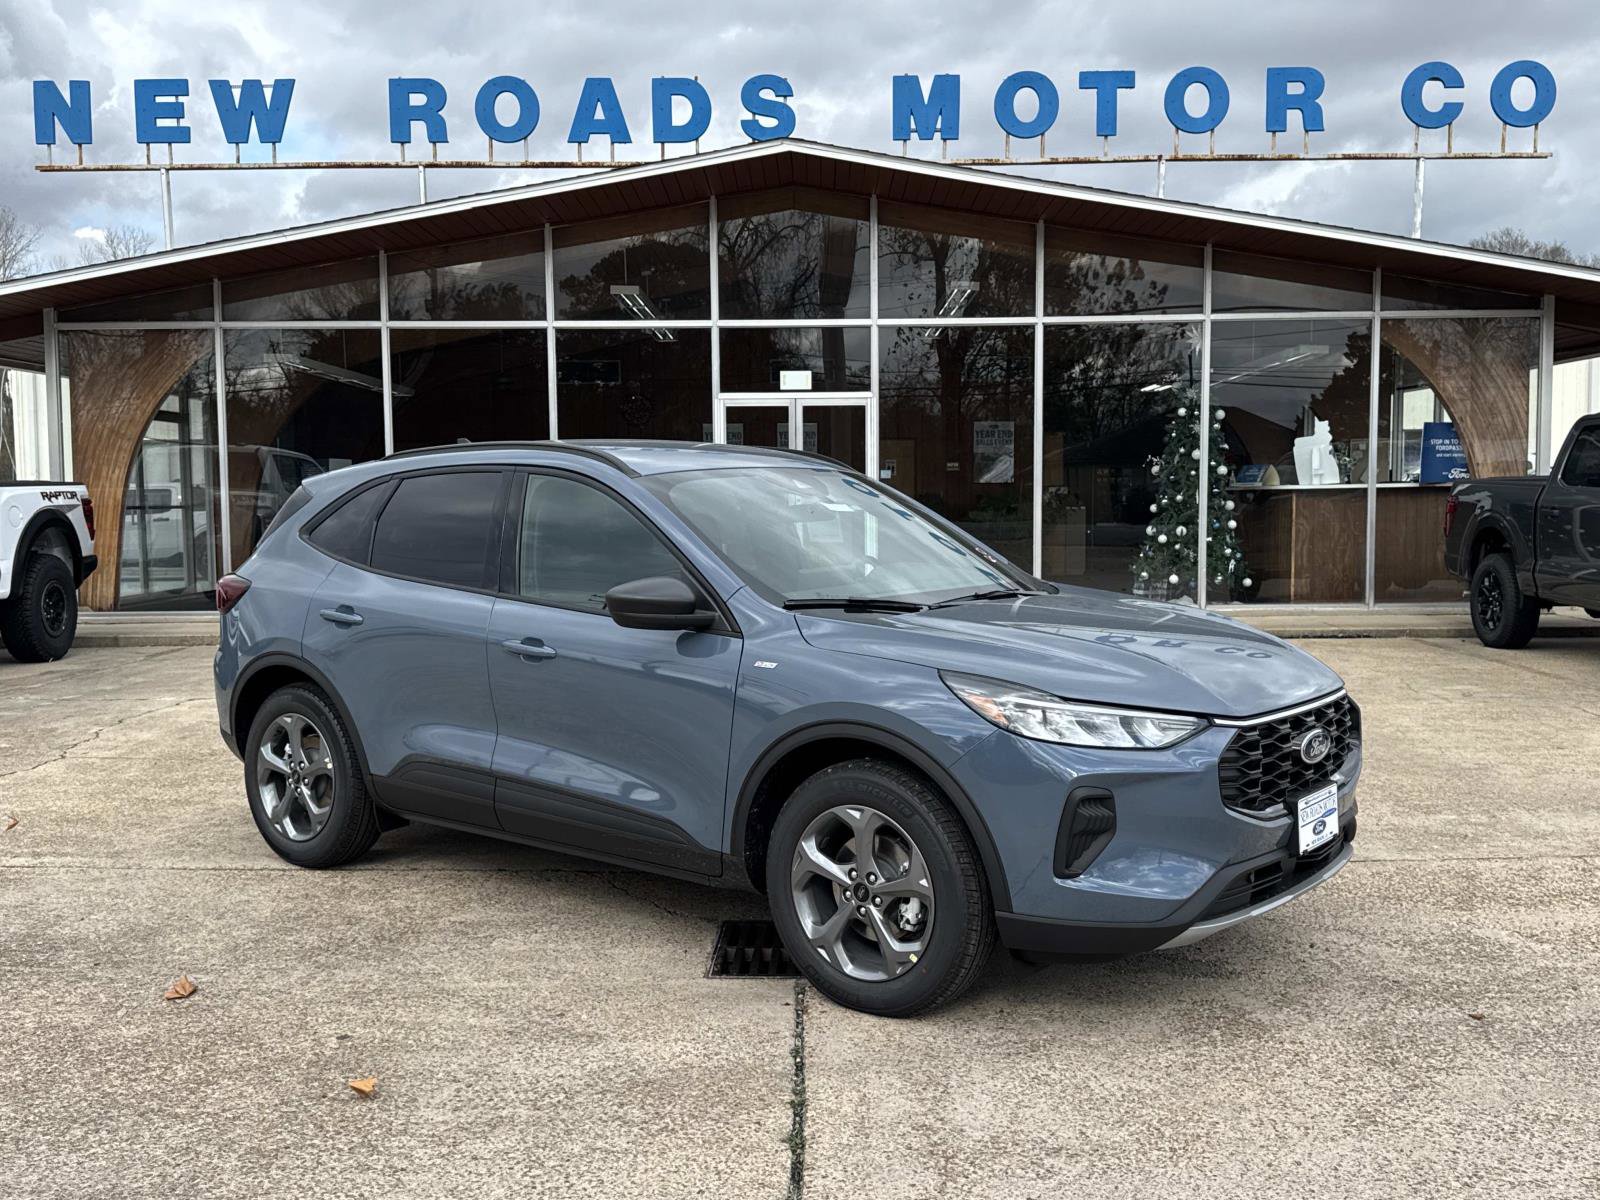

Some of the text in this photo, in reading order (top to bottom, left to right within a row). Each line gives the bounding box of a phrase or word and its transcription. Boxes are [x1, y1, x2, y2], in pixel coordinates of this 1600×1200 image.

[33, 60, 1557, 144] NEW ROADS MOTOR CO
[40, 490, 81, 503] RAPTOR
